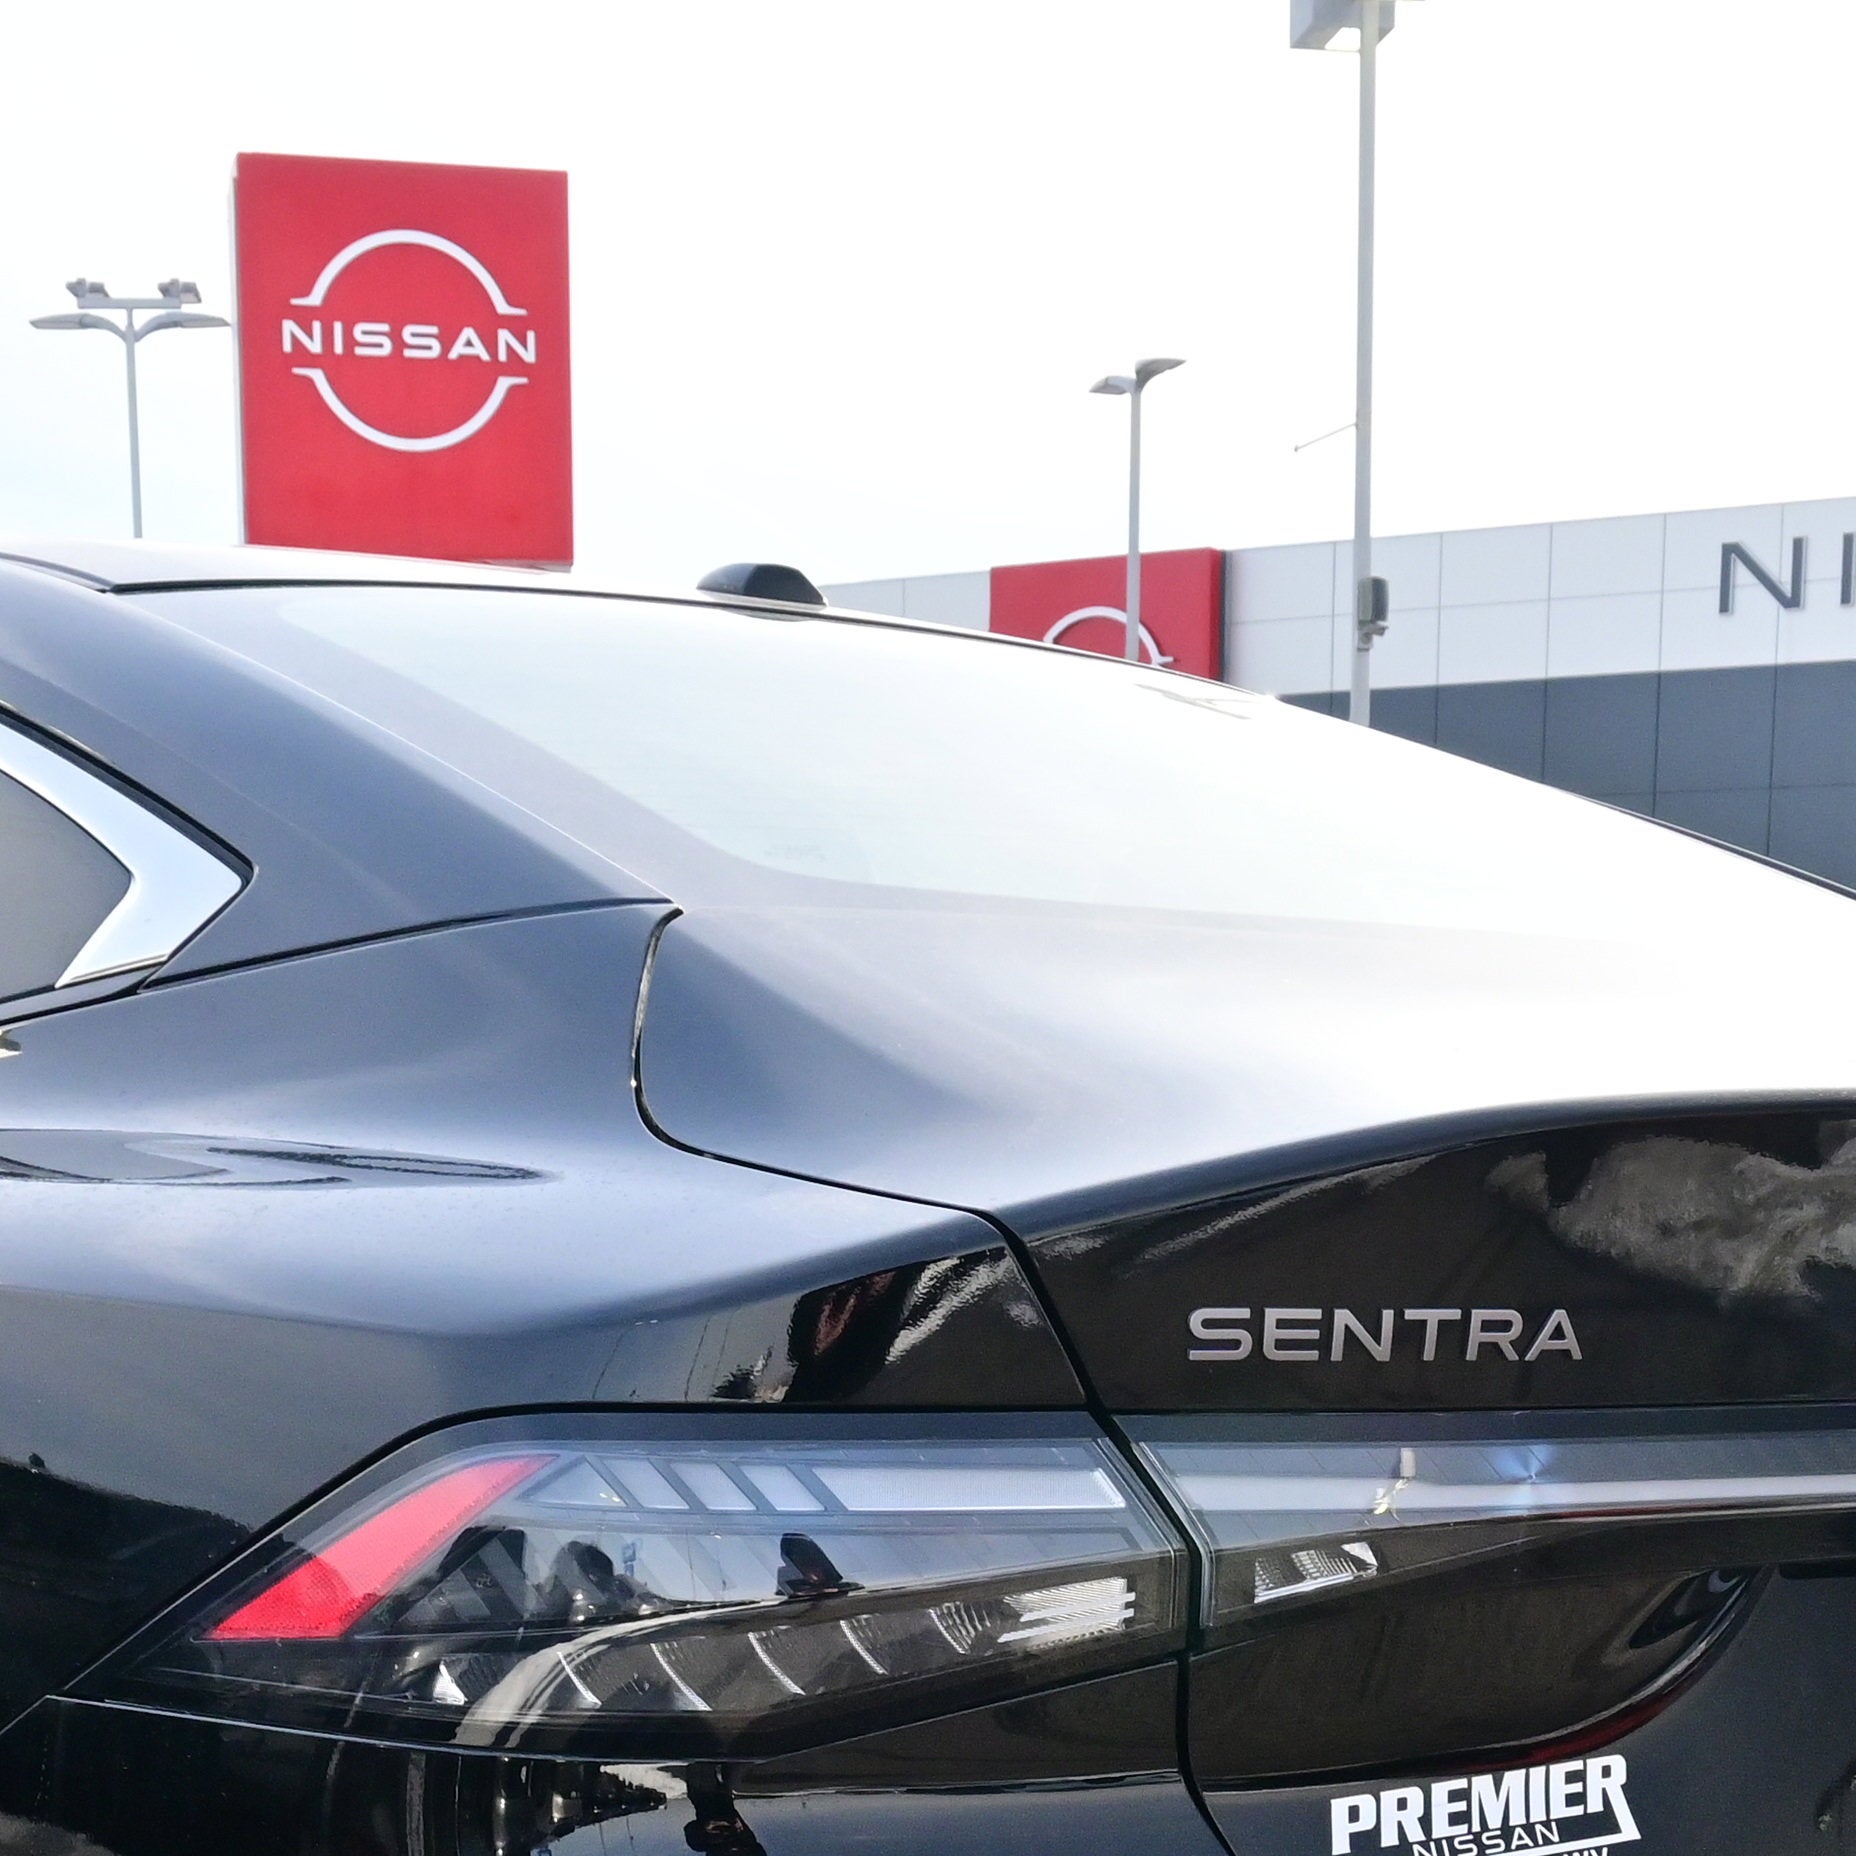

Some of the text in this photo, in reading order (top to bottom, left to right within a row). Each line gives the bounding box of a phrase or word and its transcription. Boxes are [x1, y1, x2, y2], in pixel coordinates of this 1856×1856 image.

[282, 318, 537, 364] NISSAN
[1186, 1304, 1583, 1364] SENTRA
[1330, 1753, 1630, 1856] PREMIER
